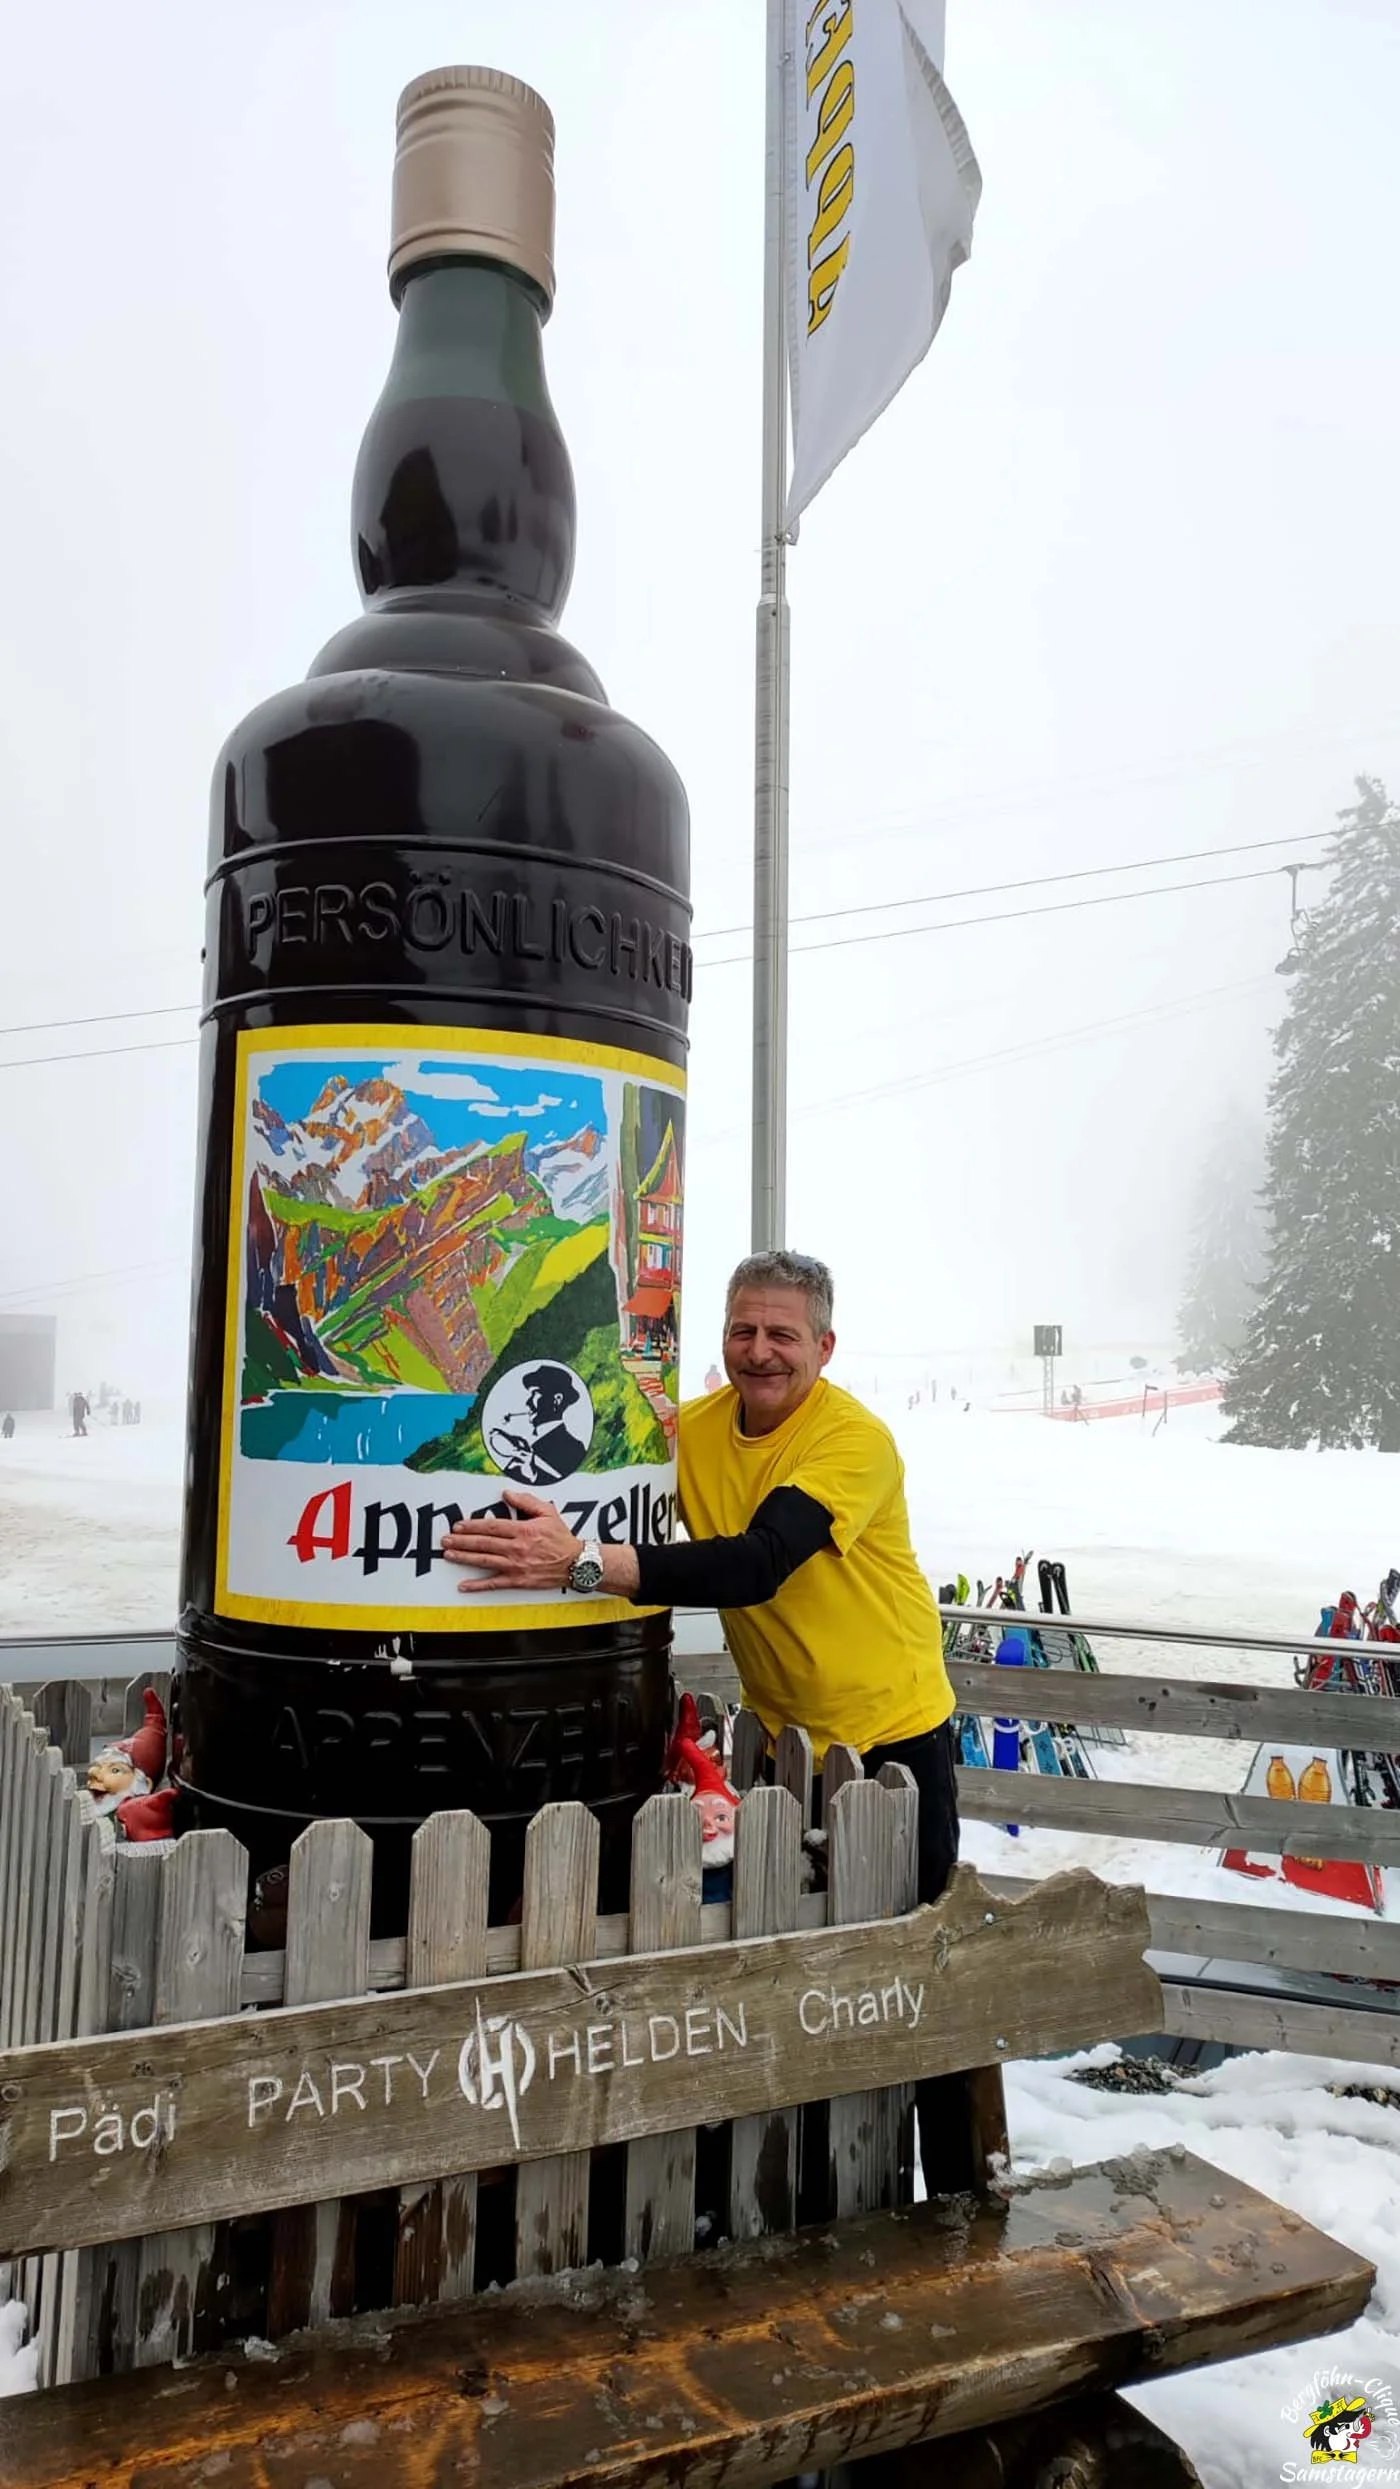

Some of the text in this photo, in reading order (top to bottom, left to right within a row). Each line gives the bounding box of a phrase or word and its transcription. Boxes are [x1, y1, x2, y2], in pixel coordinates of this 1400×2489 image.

[247, 868, 694, 1005] PERSÖNLICHKEI
[286, 1480, 677, 1595] Appzeller
[48, 2092, 178, 2162] Pädi
[247, 2049, 441, 2128] PARTY
[547, 2002, 750, 2080] HELDEN
[798, 1976, 926, 2036] Charly
